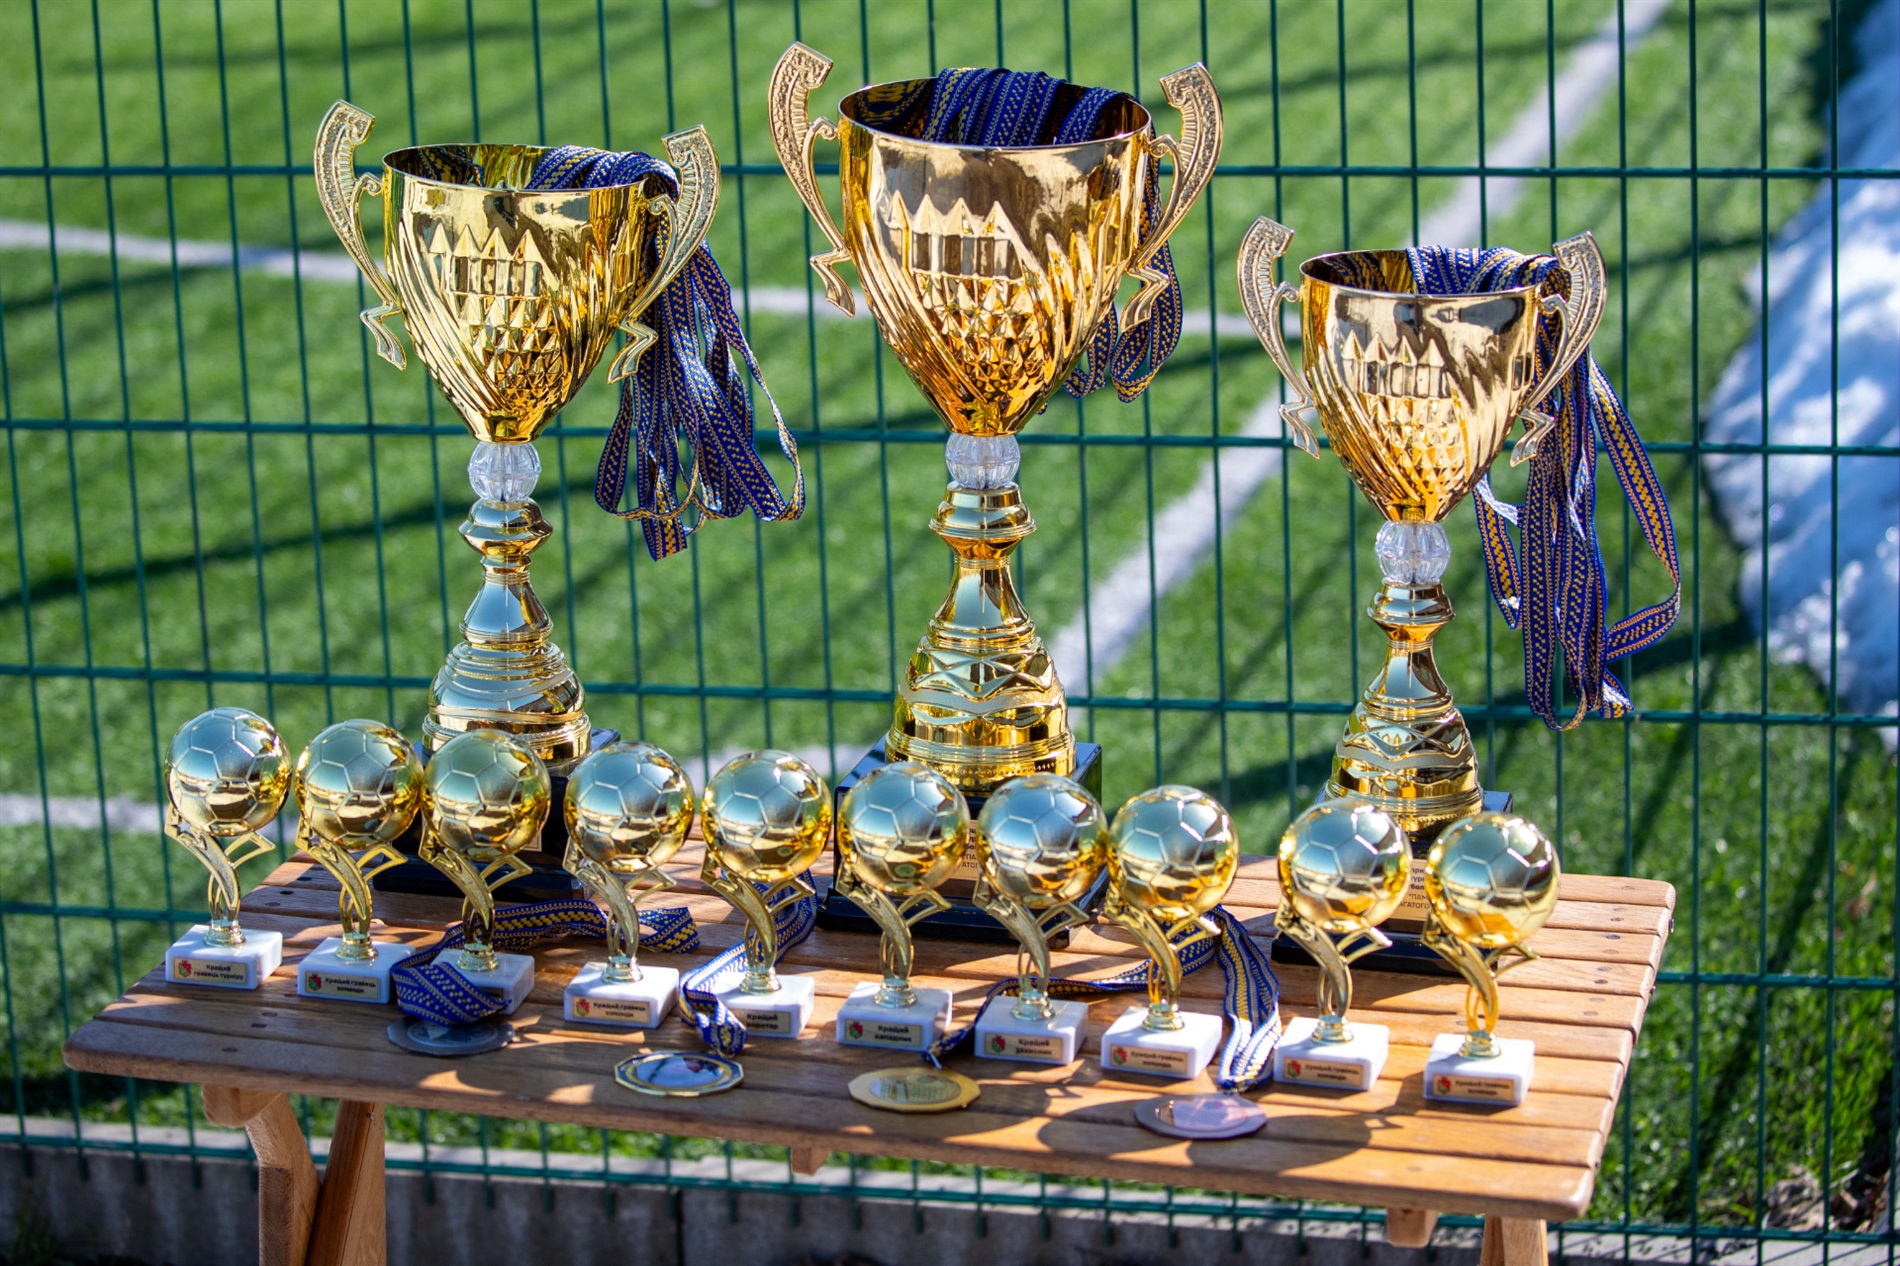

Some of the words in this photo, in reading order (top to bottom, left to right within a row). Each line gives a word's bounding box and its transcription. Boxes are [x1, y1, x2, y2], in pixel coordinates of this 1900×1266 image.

[206, 964, 231, 972] Кращий
[325, 977, 350, 985] Кращий
[747, 1013, 778, 1021] Кращий
[878, 1025, 909, 1033] Кращий
[874, 1034, 912, 1042] нападник
[1015, 1047, 1052, 1055] захисник
